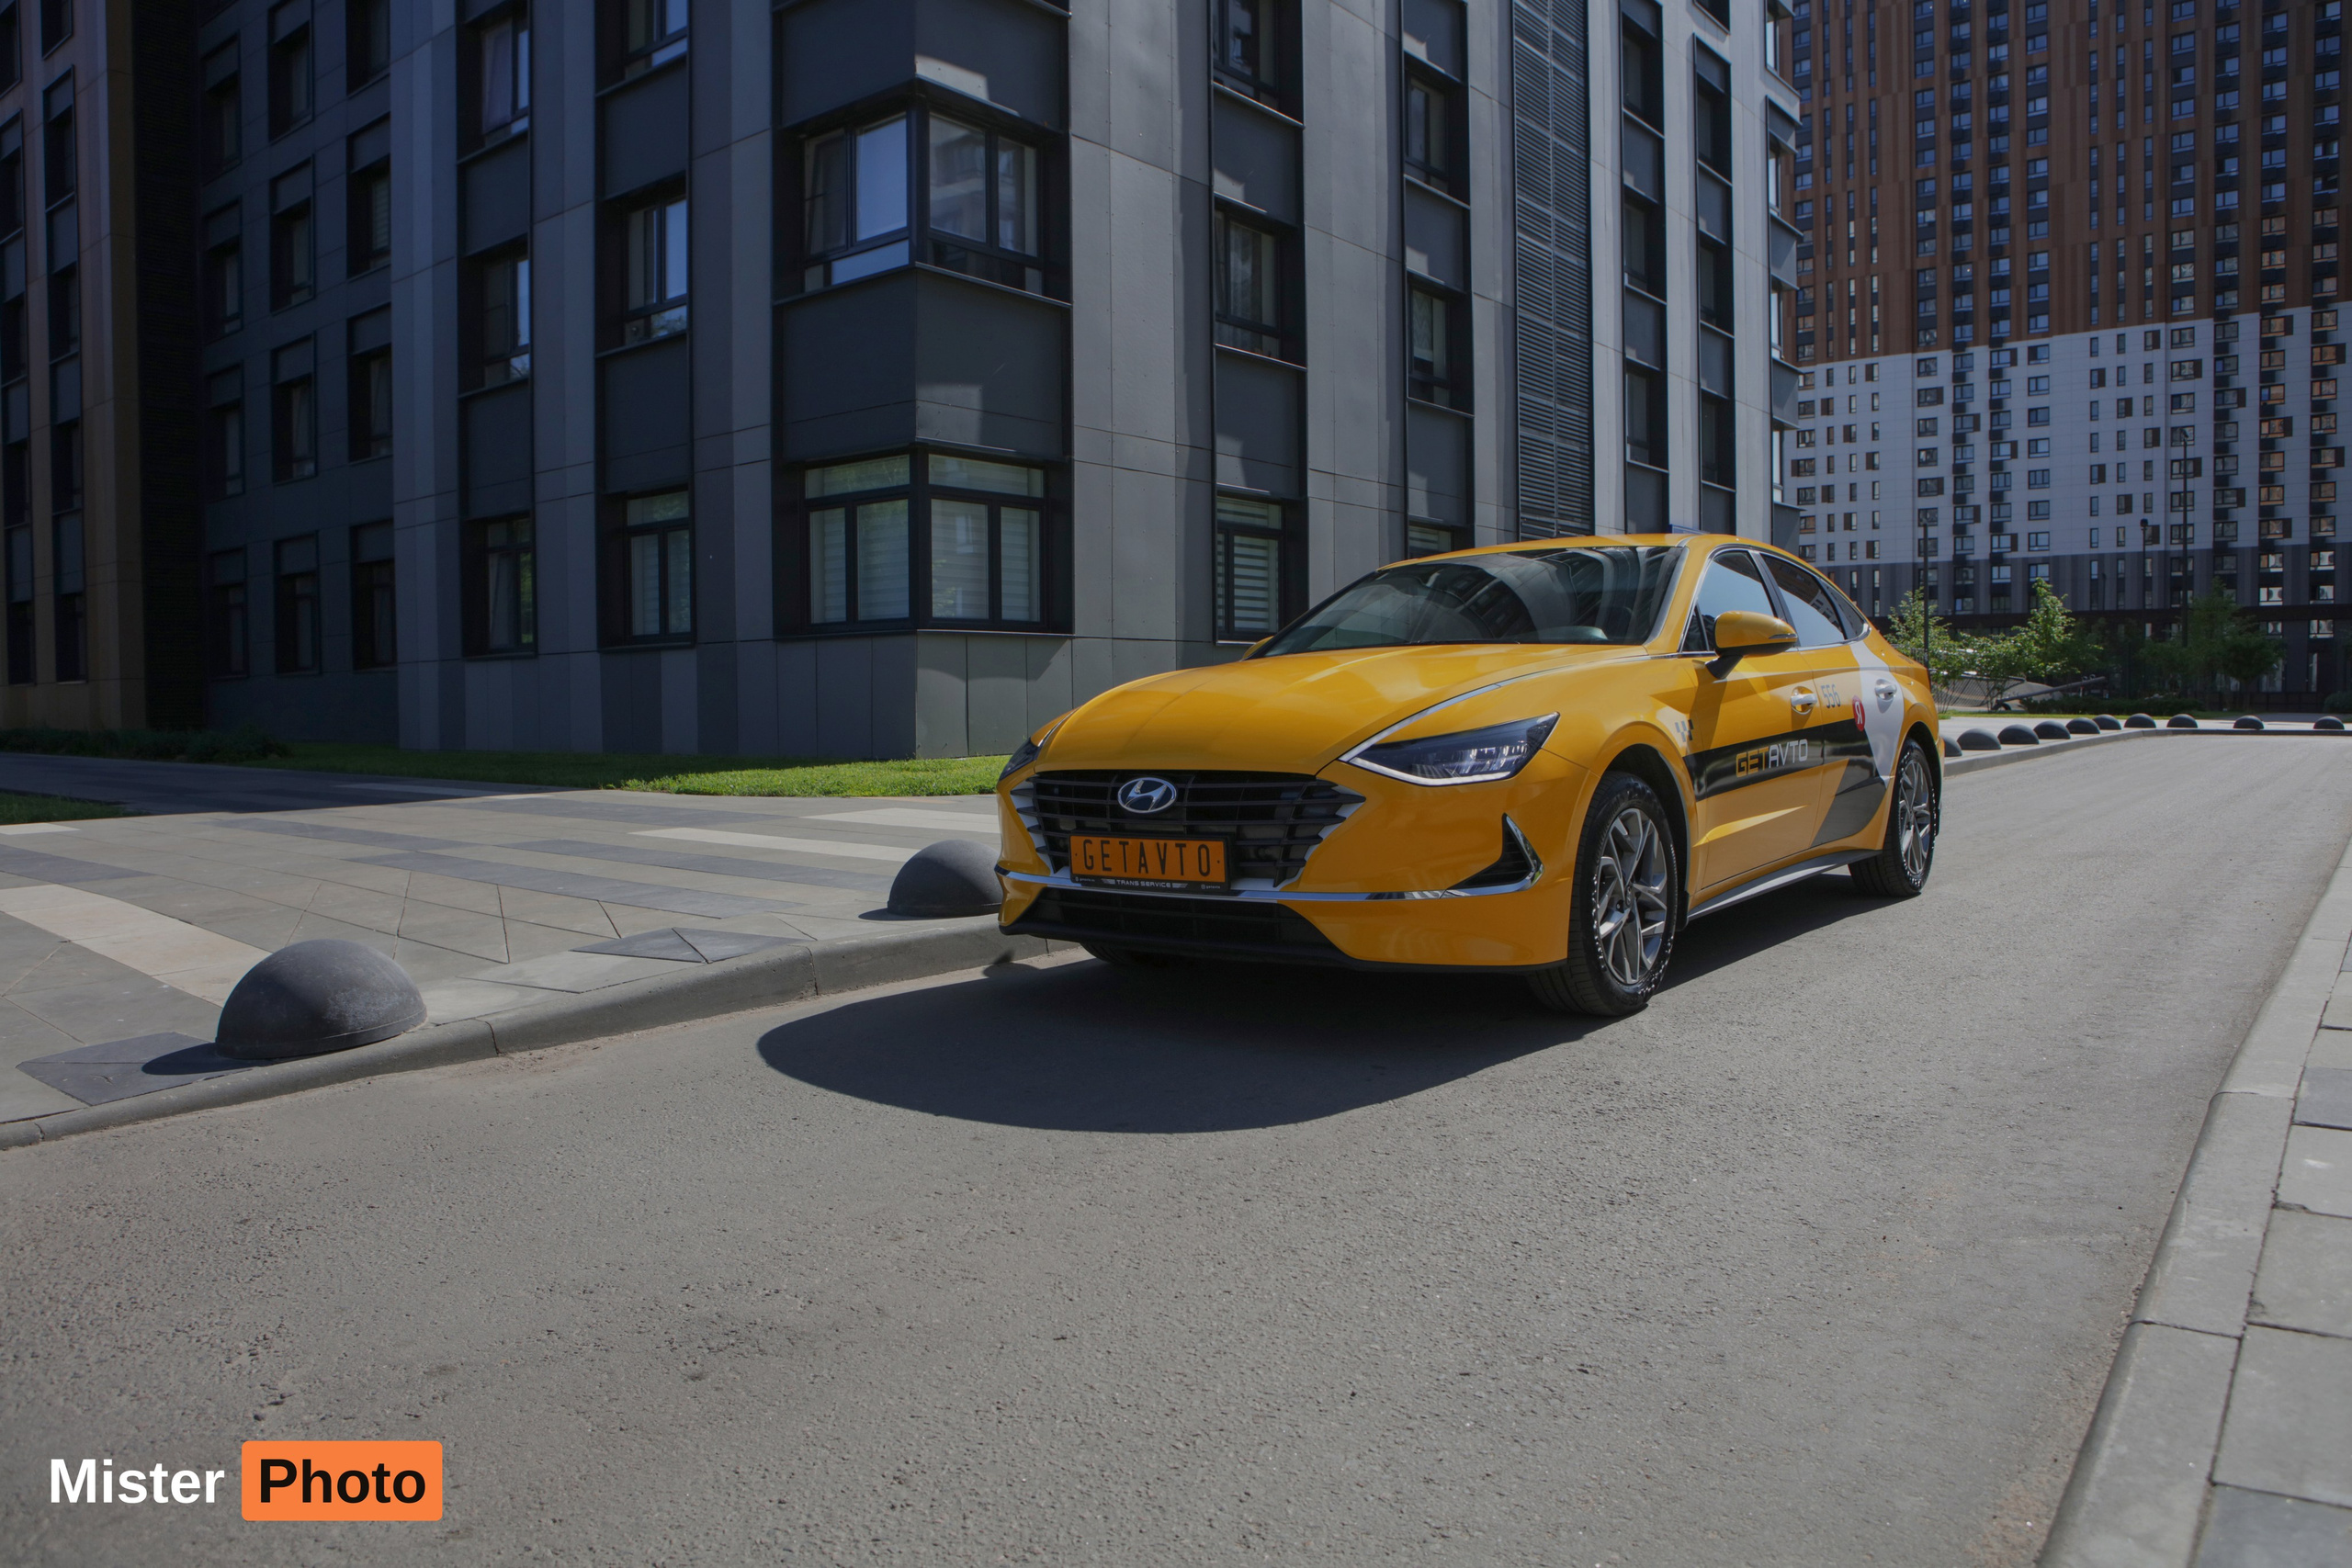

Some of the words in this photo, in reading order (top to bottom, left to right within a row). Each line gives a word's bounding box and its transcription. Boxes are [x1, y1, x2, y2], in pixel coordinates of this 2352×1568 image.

[1821, 684, 1841, 708] 556
[1855, 701, 1863, 725] Я
[1736, 739, 1808, 778] GETAVTO
[1082, 839, 1211, 877] GETAVTO
[1116, 879, 1139, 887] TRANS
[1140, 880, 1171, 888] SERVICE
